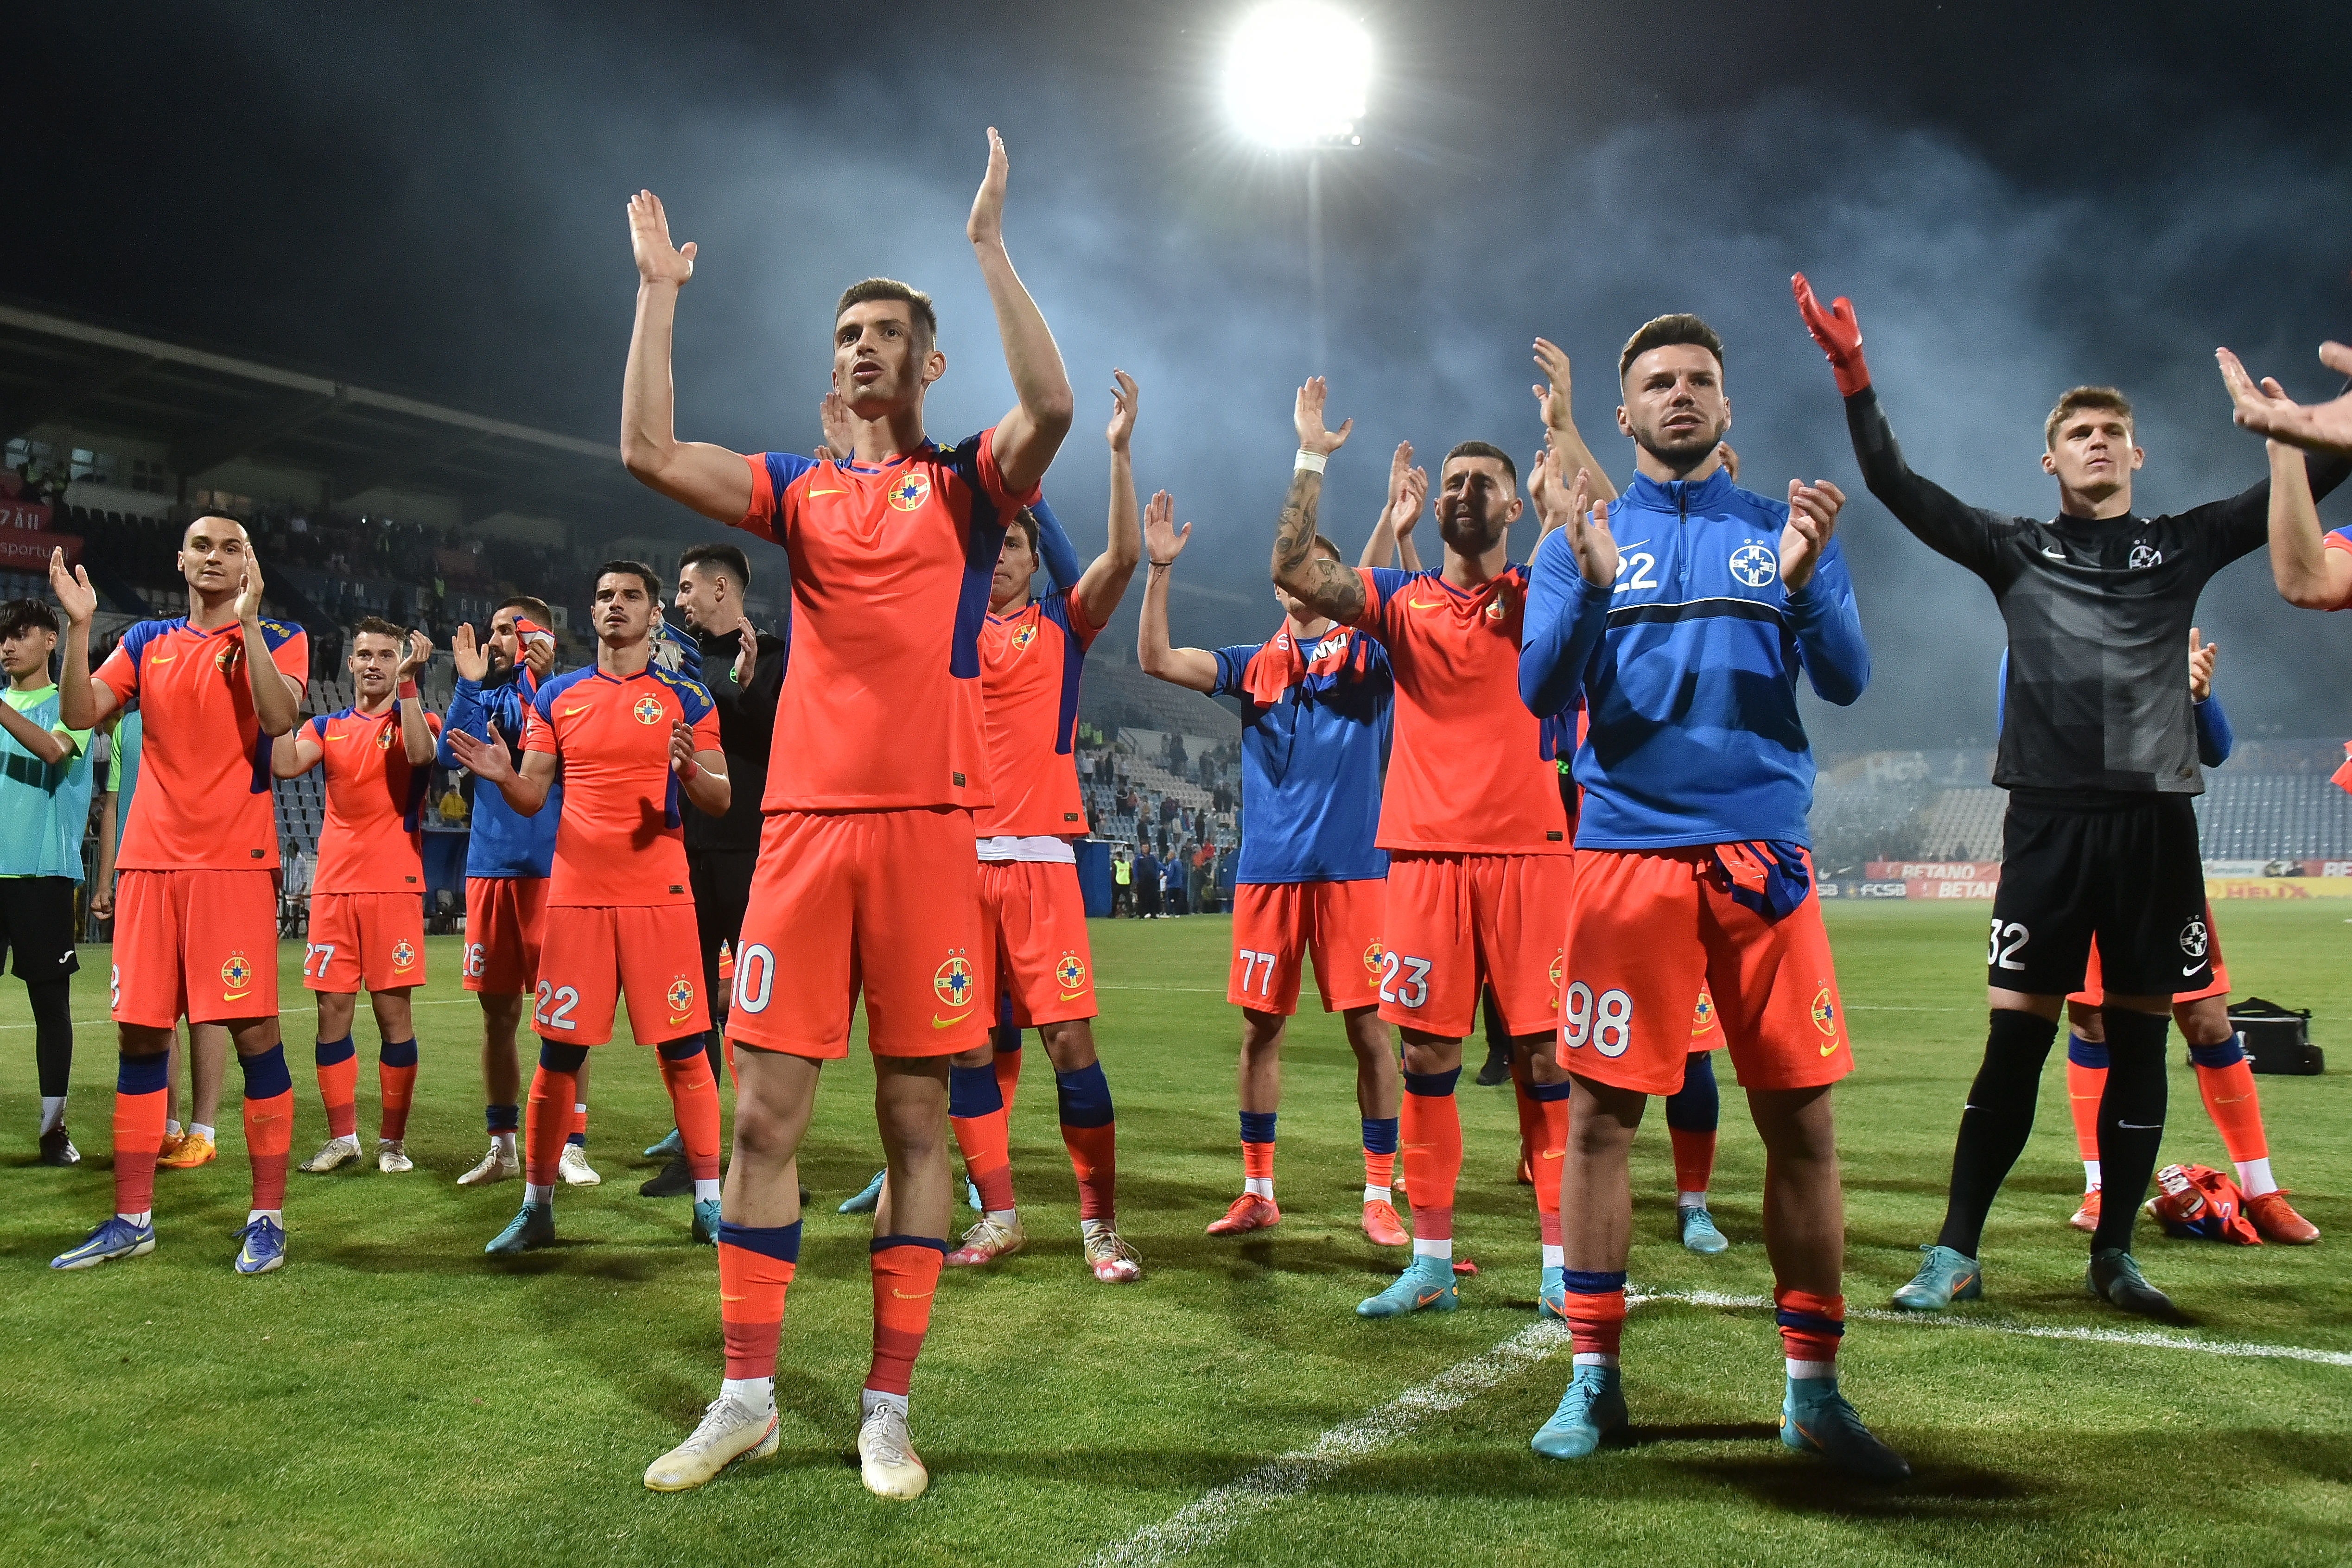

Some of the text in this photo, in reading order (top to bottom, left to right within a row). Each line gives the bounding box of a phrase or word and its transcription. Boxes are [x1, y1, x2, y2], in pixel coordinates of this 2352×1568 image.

[1816, 883, 1838, 896] SB
[1861, 883, 1906, 897] FCSB
[1901, 864, 1976, 879] BETANO
[304, 942, 335, 978] 27
[1988, 918, 2029, 971] 32
[1240, 949, 1276, 996] 77
[1379, 951, 1432, 1008] 23
[535, 979, 579, 1030] 22
[1564, 980, 1633, 1058] 98
